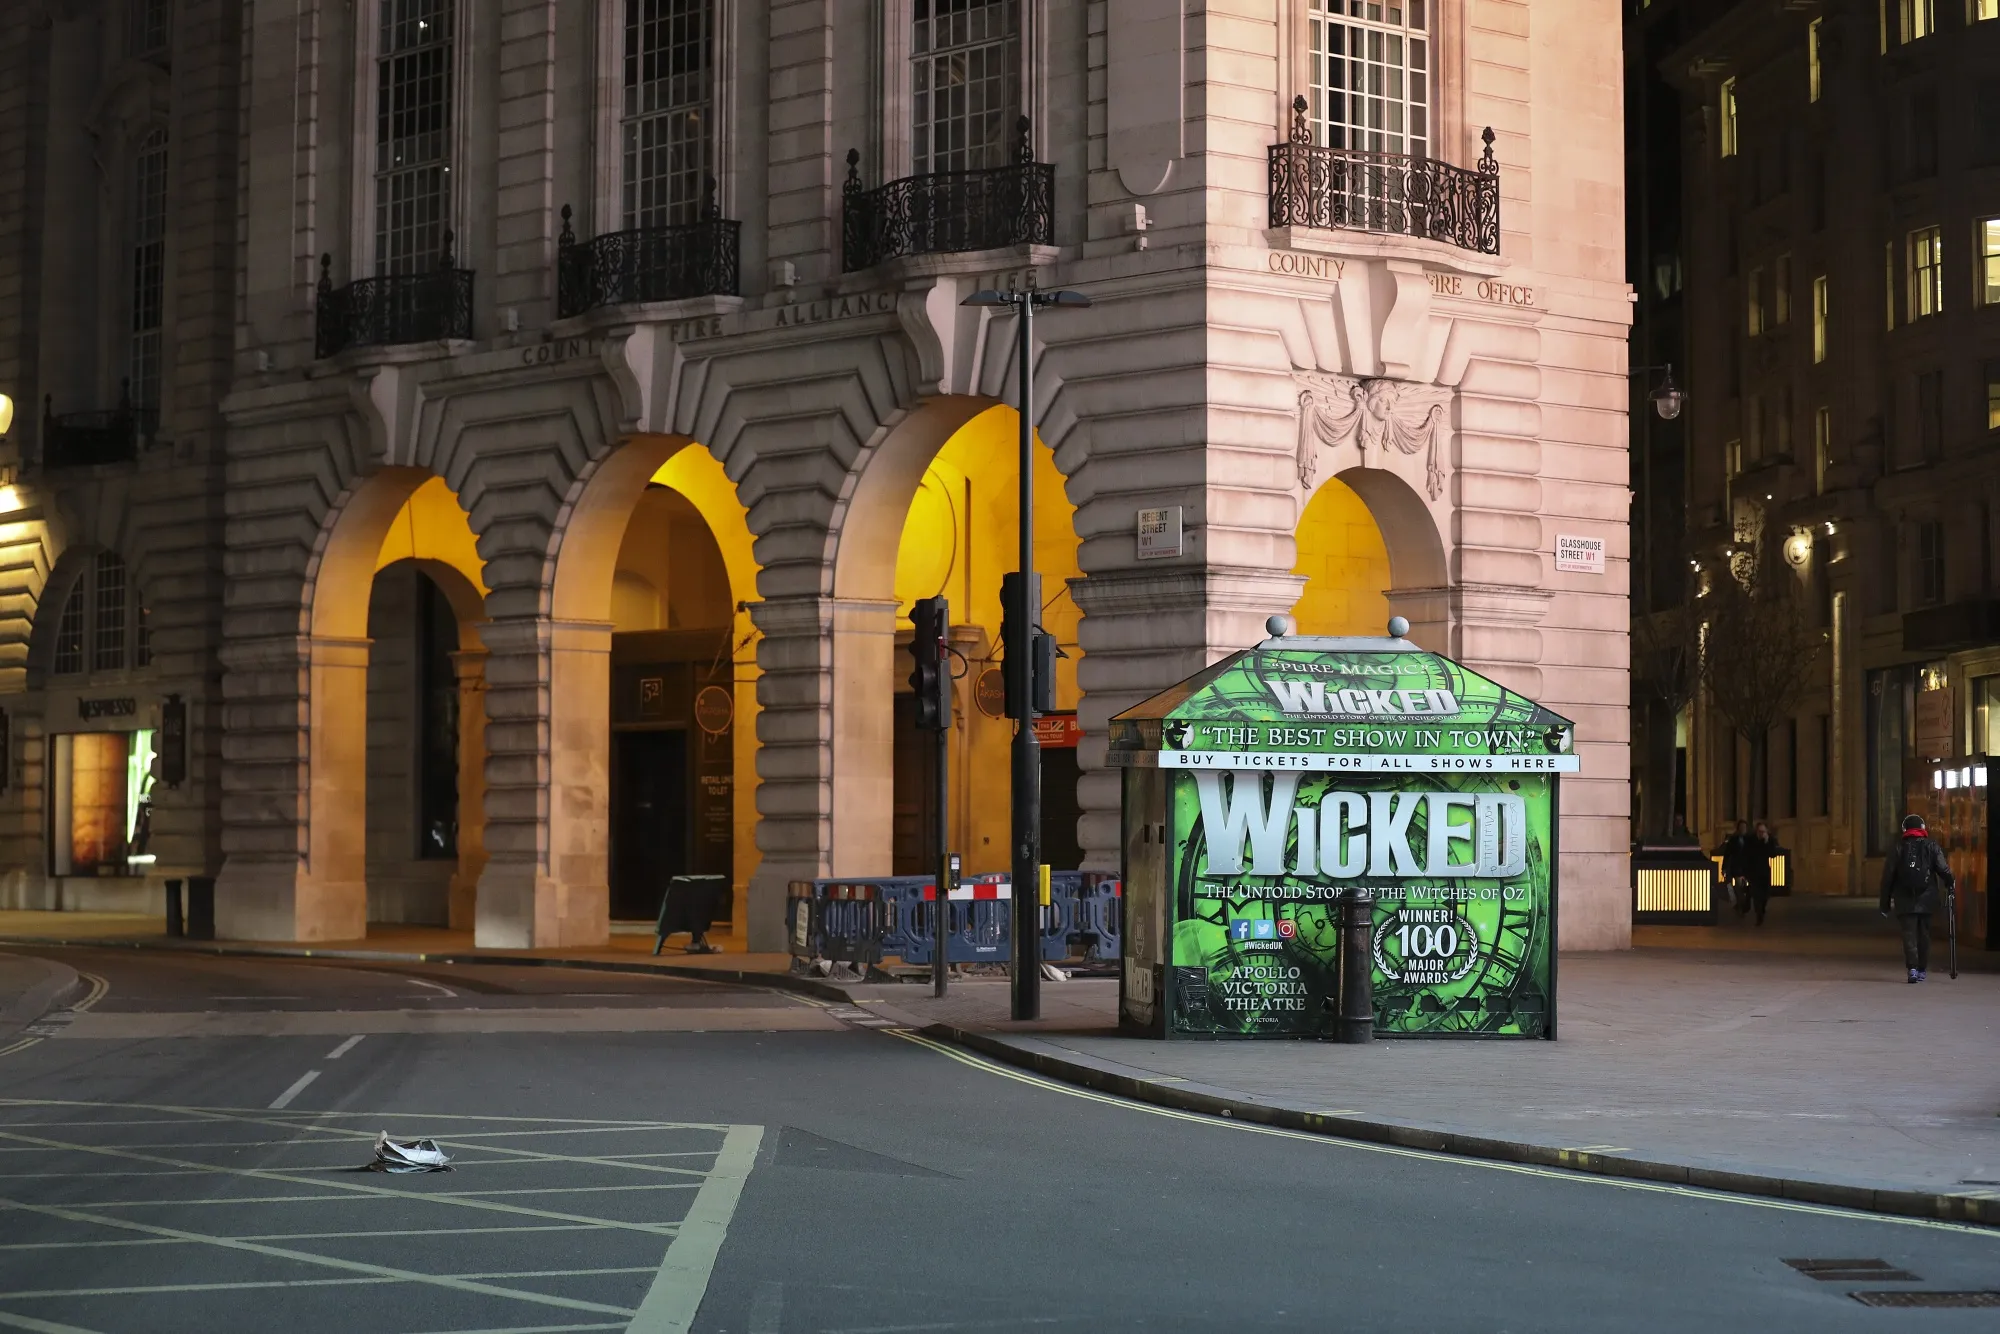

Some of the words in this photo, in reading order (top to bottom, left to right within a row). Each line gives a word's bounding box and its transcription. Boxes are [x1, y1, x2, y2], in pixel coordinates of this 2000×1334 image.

[1268, 253, 1345, 279] COUNTY
[1477, 280, 1534, 306] OFFICE
[671, 318, 722, 342] FIRE
[1141, 511, 1168, 522] REGENT
[1141, 523, 1167, 534] STREET
[1141, 536, 1152, 546] W1
[1560, 538, 1602, 551] GLASSHOUSE
[1560, 549, 1584, 560] STREET
[1585, 551, 1595, 561] W1
[1271, 662, 1334, 674] "PURE
[1263, 680, 1460, 715] WICKED
[1398, 714, 1436, 722] WITCHES
[1202, 726, 1260, 746] "THE
[1267, 728, 1326, 747] BEST
[1333, 728, 1407, 748] SHOW
[1414, 730, 1442, 748] IN
[1448, 730, 1536, 748] TOWN."
[1180, 755, 1214, 765] BUY
[1233, 755, 1310, 767] TICKETS
[1328, 757, 1362, 767] FOR
[1381, 757, 1413, 768] ALL
[1431, 757, 1494, 768] SHOWS
[1511, 758, 1557, 768] HERE
[1188, 769, 1527, 879] WICKED
[1204, 884, 1234, 899] THE
[1238, 884, 1301, 899] UNTOLD
[1379, 888, 1407, 899] THE
[1411, 886, 1477, 900] WITCHES
[1480, 888, 1500, 900] OF
[1503, 886, 1525, 900] OZ
[1398, 909, 1454, 923] WINNER!
[1244, 942, 1283, 950] #WickedUK
[1395, 924, 1458, 957] 100
[1408, 959, 1444, 971] MAJOR
[1230, 966, 1301, 979] APOLLO
[1403, 972, 1449, 984] AWARDS
[1221, 982, 1309, 995] VICTORIA
[1224, 998, 1306, 1011] THEATRE
